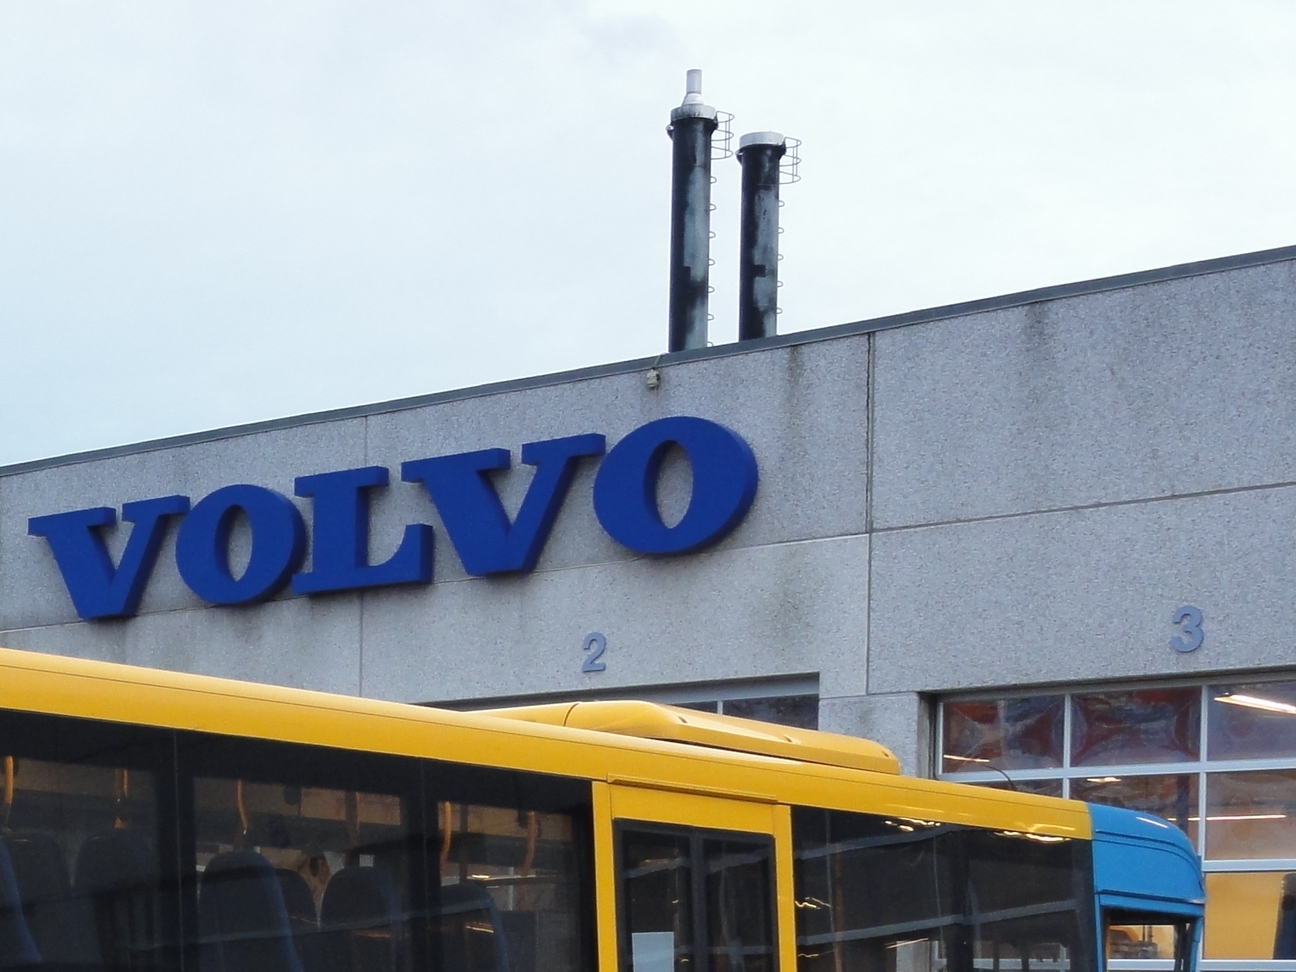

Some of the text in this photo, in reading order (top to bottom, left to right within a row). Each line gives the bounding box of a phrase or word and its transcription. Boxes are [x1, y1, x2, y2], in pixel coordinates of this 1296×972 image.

[28, 416, 759, 621] VOLVO
[581, 632, 606, 672] 2
[1169, 605, 1204, 653] 3
